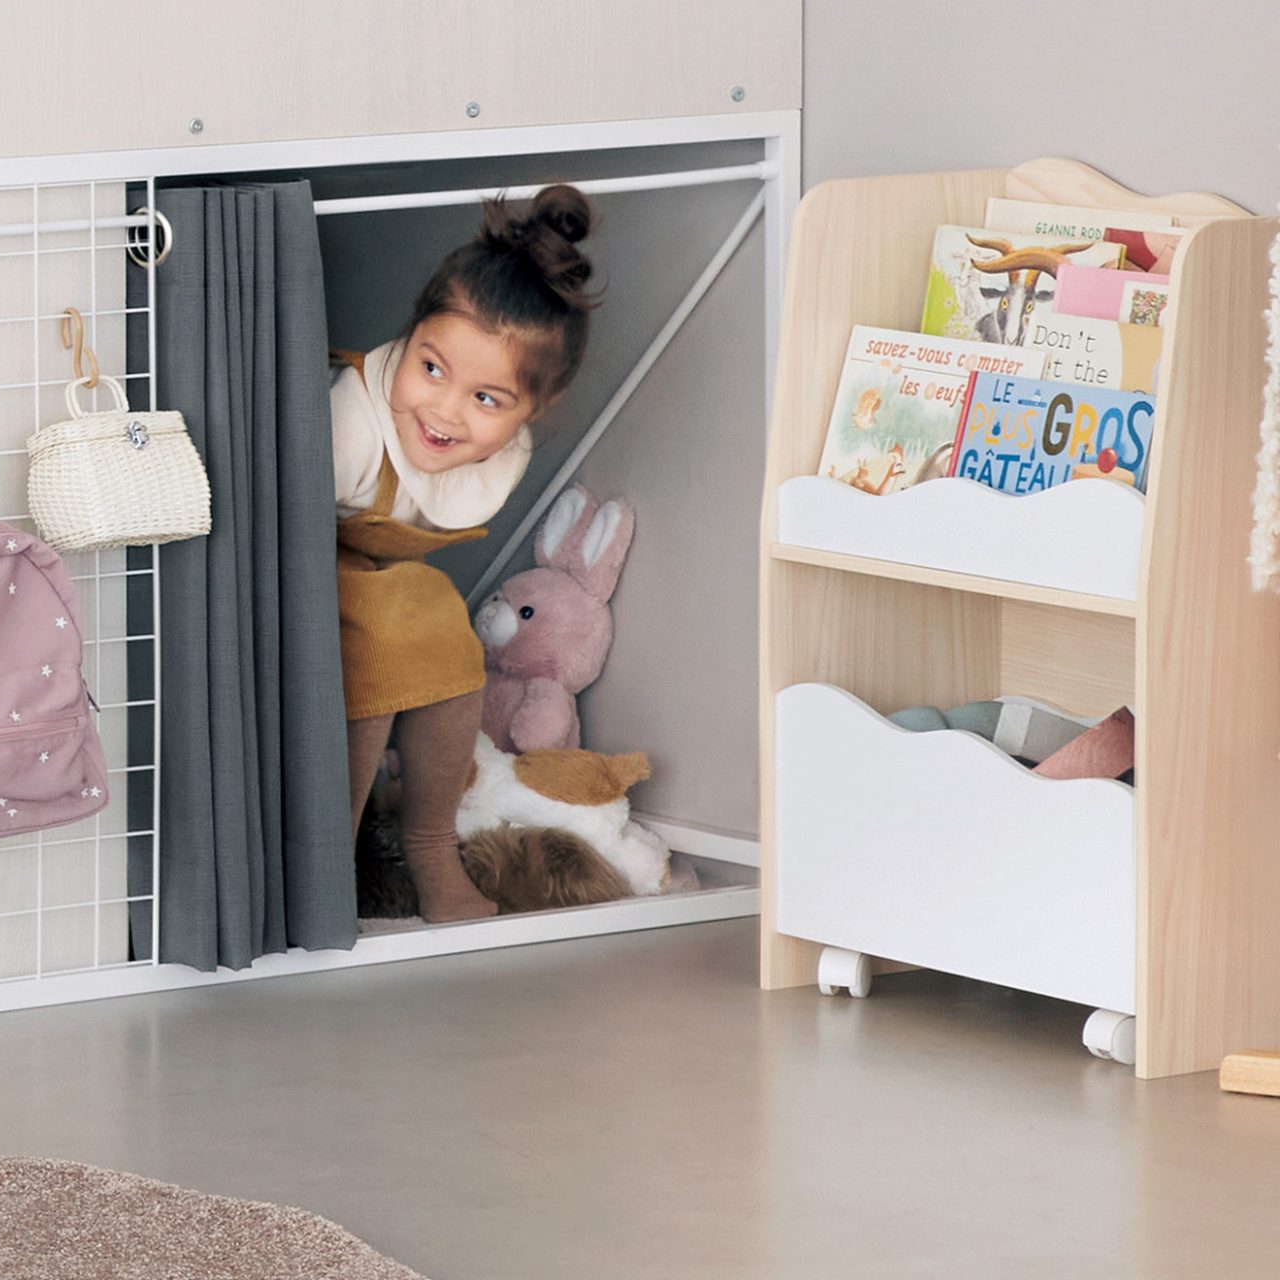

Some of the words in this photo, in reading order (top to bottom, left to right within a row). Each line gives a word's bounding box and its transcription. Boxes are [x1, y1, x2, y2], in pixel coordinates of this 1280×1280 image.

[1035, 222, 1076, 238] GIANNI
[1033, 325, 1096, 353] Don't
[866, 339, 953, 366] savez-vous
[957, 354, 1024, 376] compter
[1074, 360, 1109, 384] the
[899, 375, 920, 397] les
[992, 379, 1015, 404] LE
[968, 403, 1038, 449] PLUS
[1042, 393, 1154, 471] GROS
